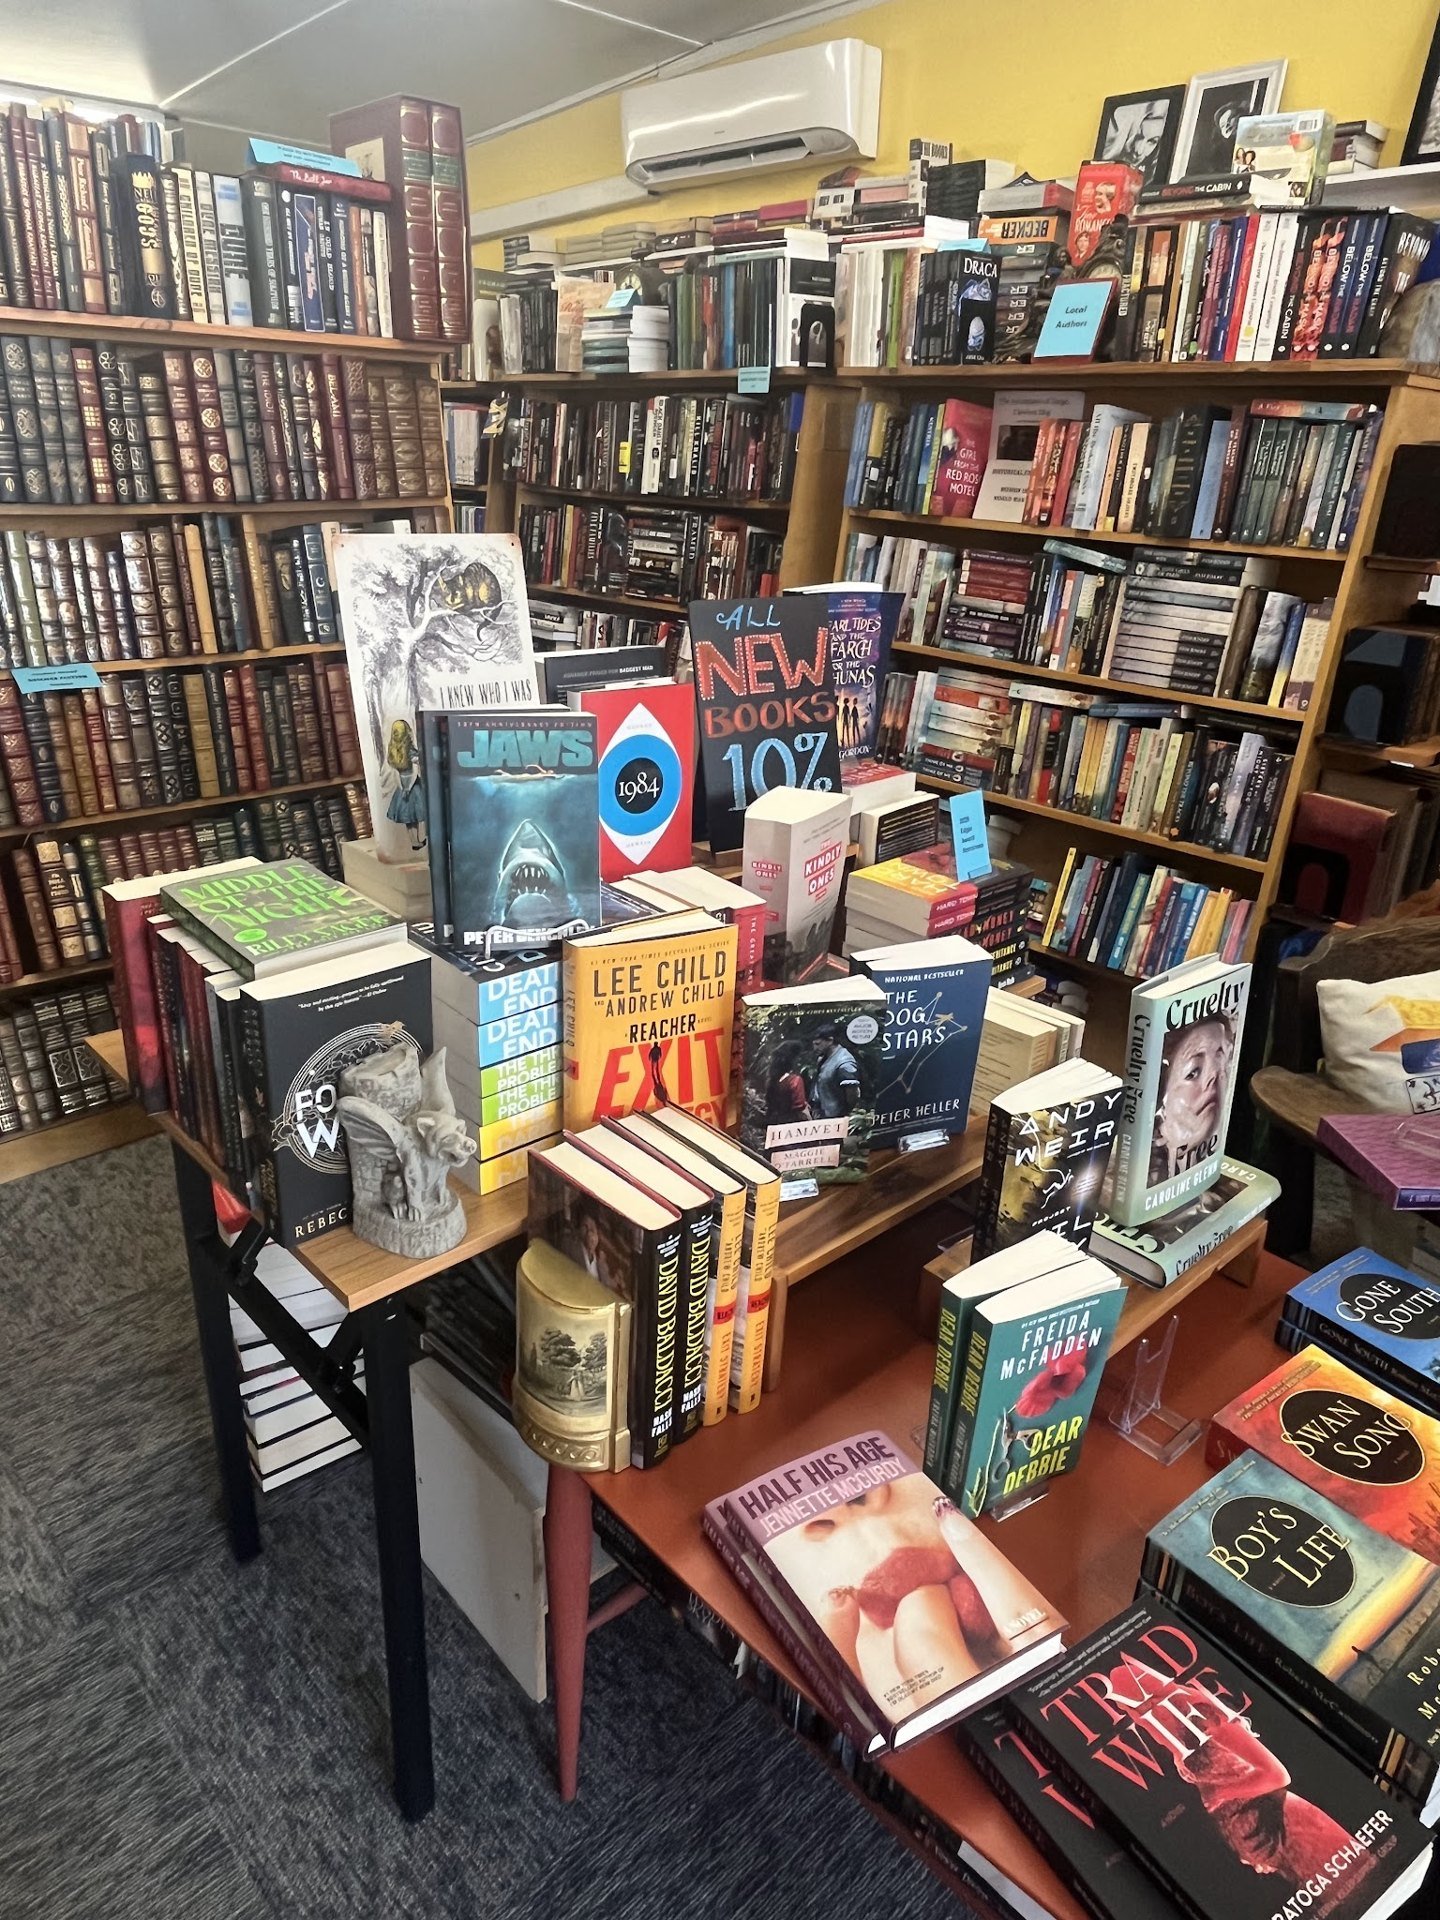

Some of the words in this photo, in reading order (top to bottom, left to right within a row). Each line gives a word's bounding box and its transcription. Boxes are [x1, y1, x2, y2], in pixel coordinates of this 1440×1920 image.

[1206, 181, 1232, 193] CABIN
[1000, 219, 1049, 239] BECKER
[963, 257, 998, 278] DRACA
[1340, 246, 1355, 283] BELOW
[1359, 244, 1375, 282] BELOW
[1064, 305, 1088, 314] Local
[1118, 273, 1130, 317] FRACTURED
[1055, 320, 1088, 329] Authors
[1280, 308, 1293, 340] CABIN
[953, 460, 969, 470] FROM
[959, 448, 977, 460] GIRL
[946, 469, 963, 482] RED
[963, 472, 981, 484] ROS
[949, 482, 976, 498] MOTEL
[688, 515, 699, 560] FRAMED
[716, 604, 781, 631] ALL
[849, 631, 866, 640] THE
[852, 616, 882, 632] TIDES
[695, 626, 829, 700] NEW
[845, 660, 862, 670] THE
[449, 686, 475, 709] KNEW
[478, 684, 501, 706] WHO
[511, 679, 532, 703] WAS
[704, 691, 837, 739] BOOKS
[456, 729, 594, 768] JAWS
[618, 771, 660, 804] 1984
[722, 731, 833, 812] 10%
[805, 841, 843, 877] KINDLY
[179, 864, 317, 902] MIDDLE
[200, 892, 247, 914] OF
[254, 876, 337, 900] THE
[808, 868, 835, 894] ONES
[593, 964, 643, 998] LEE
[657, 950, 727, 989] CHILD
[884, 973, 922, 984] NATIONAL
[923, 968, 965, 981] BESTSELLER
[503, 986, 558, 1016] END
[605, 990, 675, 1018] ANDREW
[682, 980, 725, 1005] CHILD
[886, 989, 918, 1005] THE
[1165, 979, 1245, 1034] Cruelty
[502, 1028, 558, 1060] END
[629, 1013, 697, 1043] REACHER
[881, 1026, 948, 1052] STARS
[497, 1057, 528, 1078] THE
[1125, 1014, 1150, 1090] Cruelty
[497, 1064, 557, 1091] PROBLE
[591, 1027, 725, 1123] EXIT
[497, 1085, 528, 1106] THE
[497, 1091, 557, 1119] PROBLE
[872, 1108, 911, 1127] PETER
[915, 1099, 961, 1117] HELLER
[1018, 1091, 1122, 1136] ANDY
[1122, 1085, 1144, 1124] Free
[771, 1122, 842, 1141] HAMNET
[1014, 1120, 1116, 1167] WEIR
[783, 1148, 824, 1160] MAGGIE
[1175, 1132, 1219, 1175] Free
[1144, 1179, 1193, 1212] CAROLINE
[1192, 1158, 1219, 1189] GLENN
[295, 1207, 348, 1238] REBEC
[688, 1234, 711, 1298] DAVID
[1175, 1237, 1213, 1278] Cruelty
[1212, 1223, 1235, 1248] Free
[657, 1254, 680, 1319] DAVID
[1335, 1280, 1402, 1323] GONE
[939, 1307, 958, 1343] DEAR
[1372, 1286, 1440, 1335] SOUTH
[684, 1298, 709, 1388] BALDACCI
[967, 1330, 988, 1364] DEAR
[1021, 1310, 1091, 1352] FREIDA
[654, 1318, 678, 1413] BALDACCI
[934, 1344, 953, 1394] DEBBIE
[1000, 1326, 1103, 1381] McFADDEN
[1354, 1342, 1390, 1371] SOUTH
[682, 1382, 702, 1404] NASH
[960, 1363, 982, 1417] DEBBIE
[651, 1417, 673, 1438] FALLS
[653, 1407, 673, 1429] NASH
[1029, 1415, 1084, 1458] DEAR
[1280, 1399, 1362, 1458] SWAN
[1332, 1410, 1412, 1470] SONG
[738, 1468, 803, 1520] HALF
[801, 1452, 849, 1487] HIS
[842, 1436, 896, 1470] AGE
[1002, 1445, 1071, 1498] DEBBIE
[758, 1485, 840, 1538] JENNETTE
[836, 1456, 908, 1501] MCCURDY
[1205, 1506, 1299, 1582] BOY'S
[1272, 1522, 1351, 1589] LIFE
[1039, 1624, 1199, 1747] TRAD
[1090, 1665, 1254, 1792] WIFE
[1323, 1808, 1395, 1879] SCHAEFER
